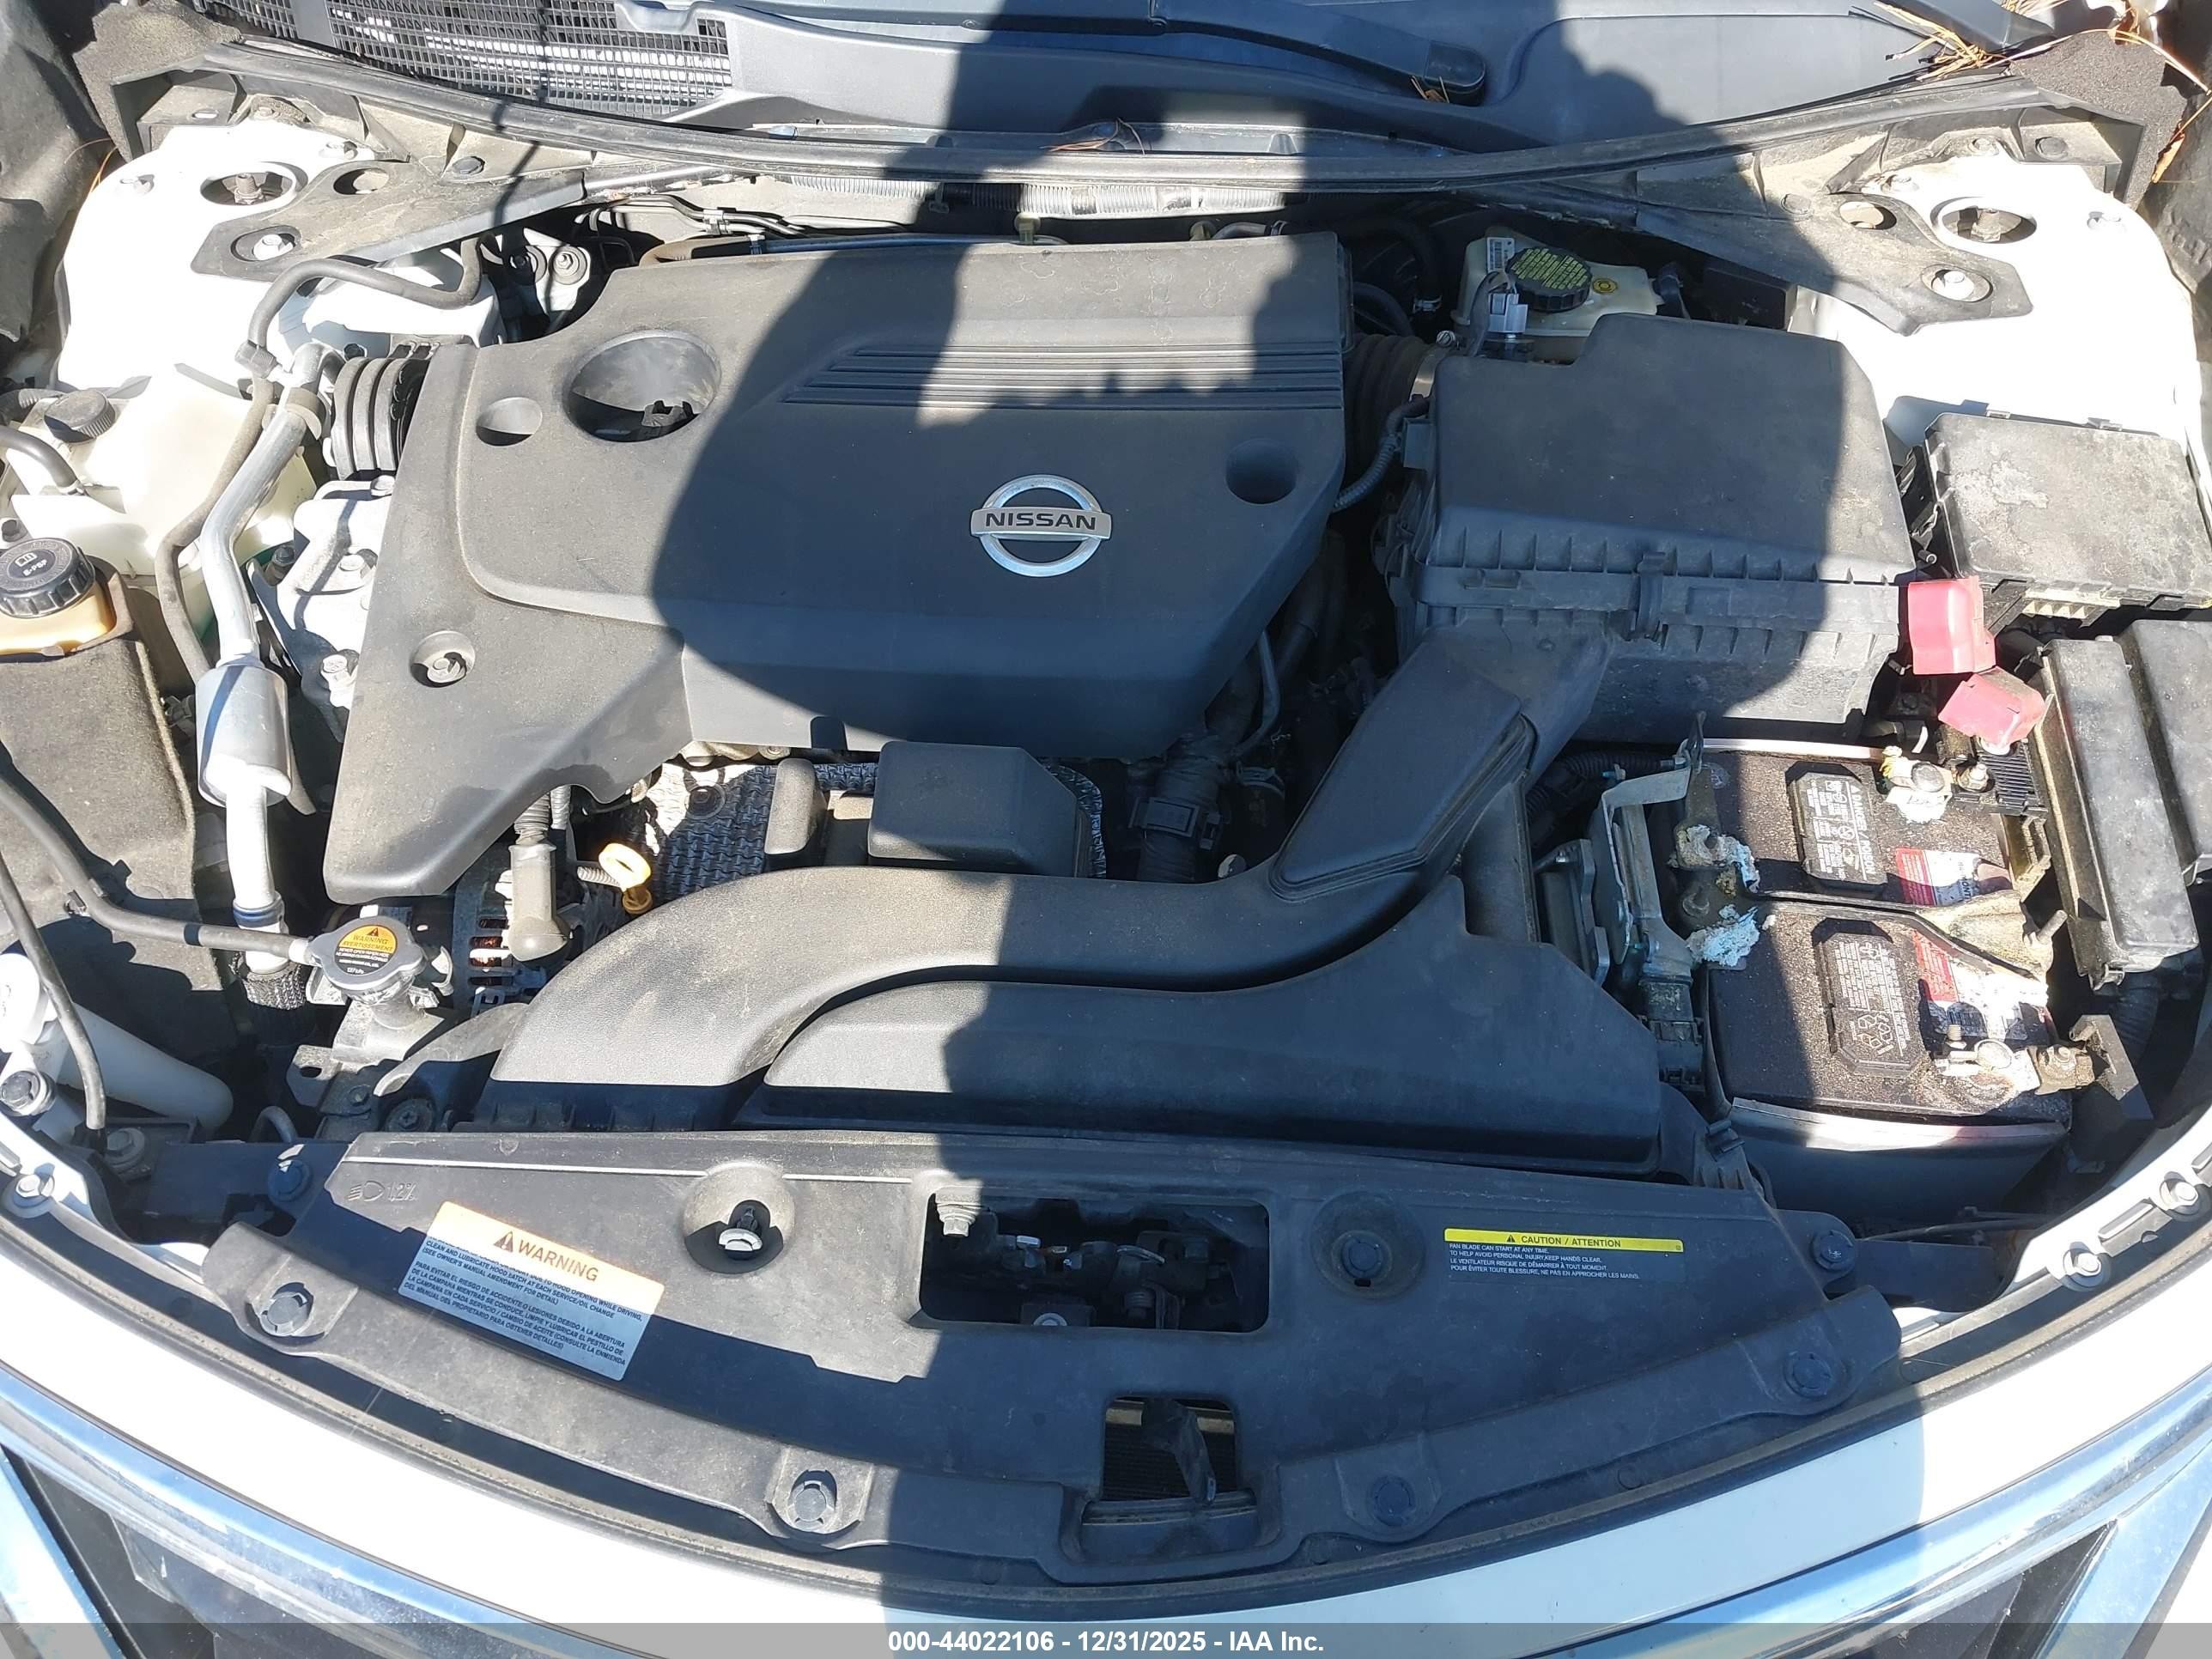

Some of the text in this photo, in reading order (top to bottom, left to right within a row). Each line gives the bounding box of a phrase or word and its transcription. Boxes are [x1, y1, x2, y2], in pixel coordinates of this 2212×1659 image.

[986, 513, 1096, 530] NISSAN
[1852, 793, 1866, 830] DANGER
[1860, 839, 1875, 875] POISON
[353, 934, 388, 944] WARNING
[519, 1238, 599, 1282] WARNING
[1458, 1257, 1494, 1266] VENTILATEUR
[1521, 1236, 1560, 1244] CAUTION
[1571, 1237, 1620, 1248] ATTENTION
[414, 1261, 430, 1271] PARA
[429, 1267, 451, 1279] EVITAR
[458, 1277, 481, 1291] RIESGO
[489, 1290, 523, 1307] ACCIDENTE
[527, 1304, 557, 1321] LESIONES
[556, 1316, 580, 1330] DEBIDO
[593, 1331, 625, 1347] ABERTURA
[425, 1240, 445, 1252] CLEAN
[445, 1248, 459, 1257] AND
[458, 1253, 489, 1269] LUBRICATE
[489, 1265, 507, 1276] HOOD
[507, 1272, 526, 1284] LATCH
[534, 1283, 552, 1293] EACH
[551, 1289, 589, 1308] SERVICE/OIL
[588, 1304, 615, 1318] CHANGE
[435, 1252, 463, 1267] OWNER'S
[462, 1262, 486, 1276] MANUAL
[486, 1272, 524, 1291] AMENDMENT
[523, 1286, 536, 1296] FOR
[536, 1291, 559, 1304] DETAIL)
[551, 1281, 570, 1293] HOOD
[570, 1289, 598, 1304] OPENING
[598, 1298, 617, 1310] WHILE
[616, 1306, 643, 1321] DRIVING,
[404, 1282, 563, 1349] DEL MANUAL DEL PROPIETARIO PARA OBTENER DETALLES)
[452, 1292, 469, 1303] CADA
[467, 1298, 496, 1314] SERVICIO
[499, 1311, 524, 1325] CAMBIO
[523, 1320, 532, 1328] DE
[532, 1323, 555, 1337] ACEITE
[553, 1332, 586, 1350] (CONSULTE
[594, 1348, 626, 1365] ENMIENDA
[455, 1285, 485, 1301] MIENTRAS
[524, 1312, 545, 1325] LIMPIE
[548, 1322, 578, 1338] LUBRICAR
[586, 1336, 614, 1352] PESTILLO
